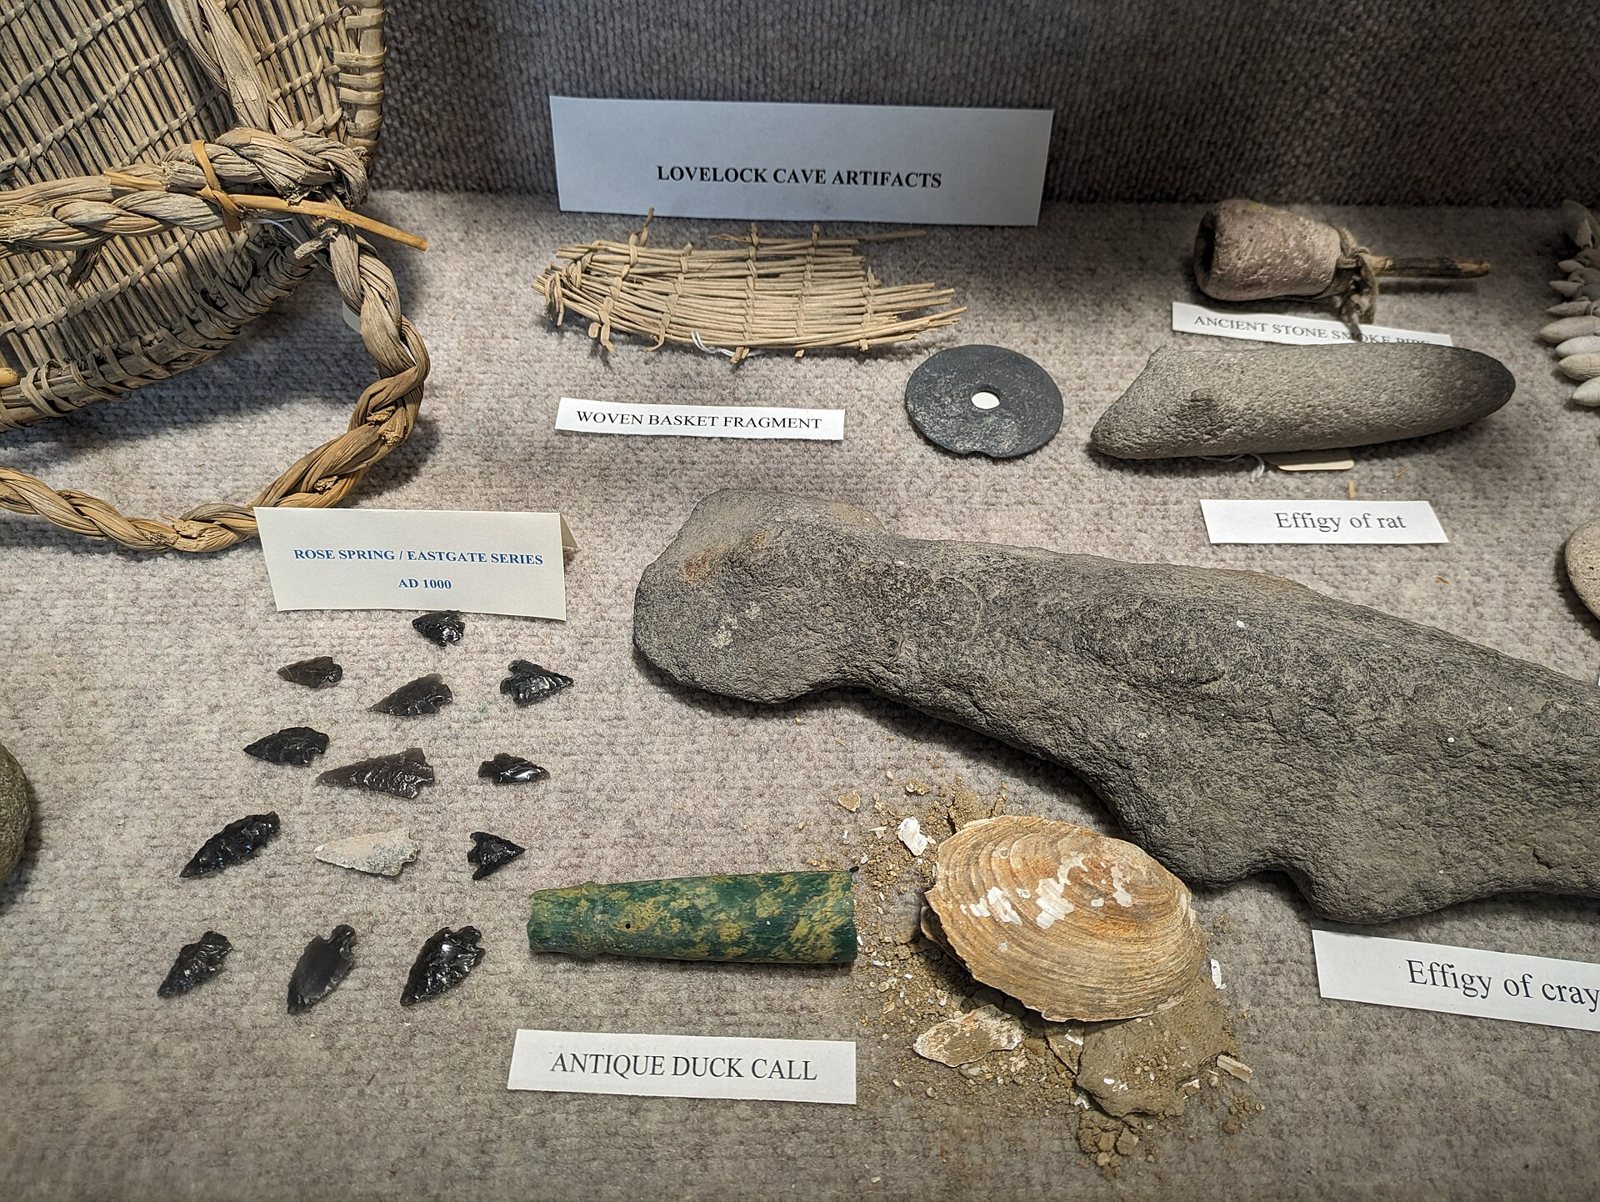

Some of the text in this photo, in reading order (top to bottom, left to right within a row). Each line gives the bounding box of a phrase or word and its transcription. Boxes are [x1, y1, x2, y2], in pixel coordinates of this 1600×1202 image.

[656, 165, 943, 189] LOVELOCK CAVE ARTIFACTS
[1194, 316, 1267, 332] ANCIENT
[1271, 323, 1328, 339] STONE
[576, 410, 823, 430] WOVEN BASKET FRAGMENT
[1273, 512, 1407, 533] Effigy of rat
[293, 549, 335, 560] ROSE
[338, 549, 395, 561] SPRING
[407, 550, 488, 563] EASTGATE
[490, 553, 544, 565] SERIES
[398, 578, 452, 590] AD 1000
[1405, 959, 1600, 1013] Effigy of cray
[550, 1052, 818, 1081] ANTIQUE DUCK CALL
